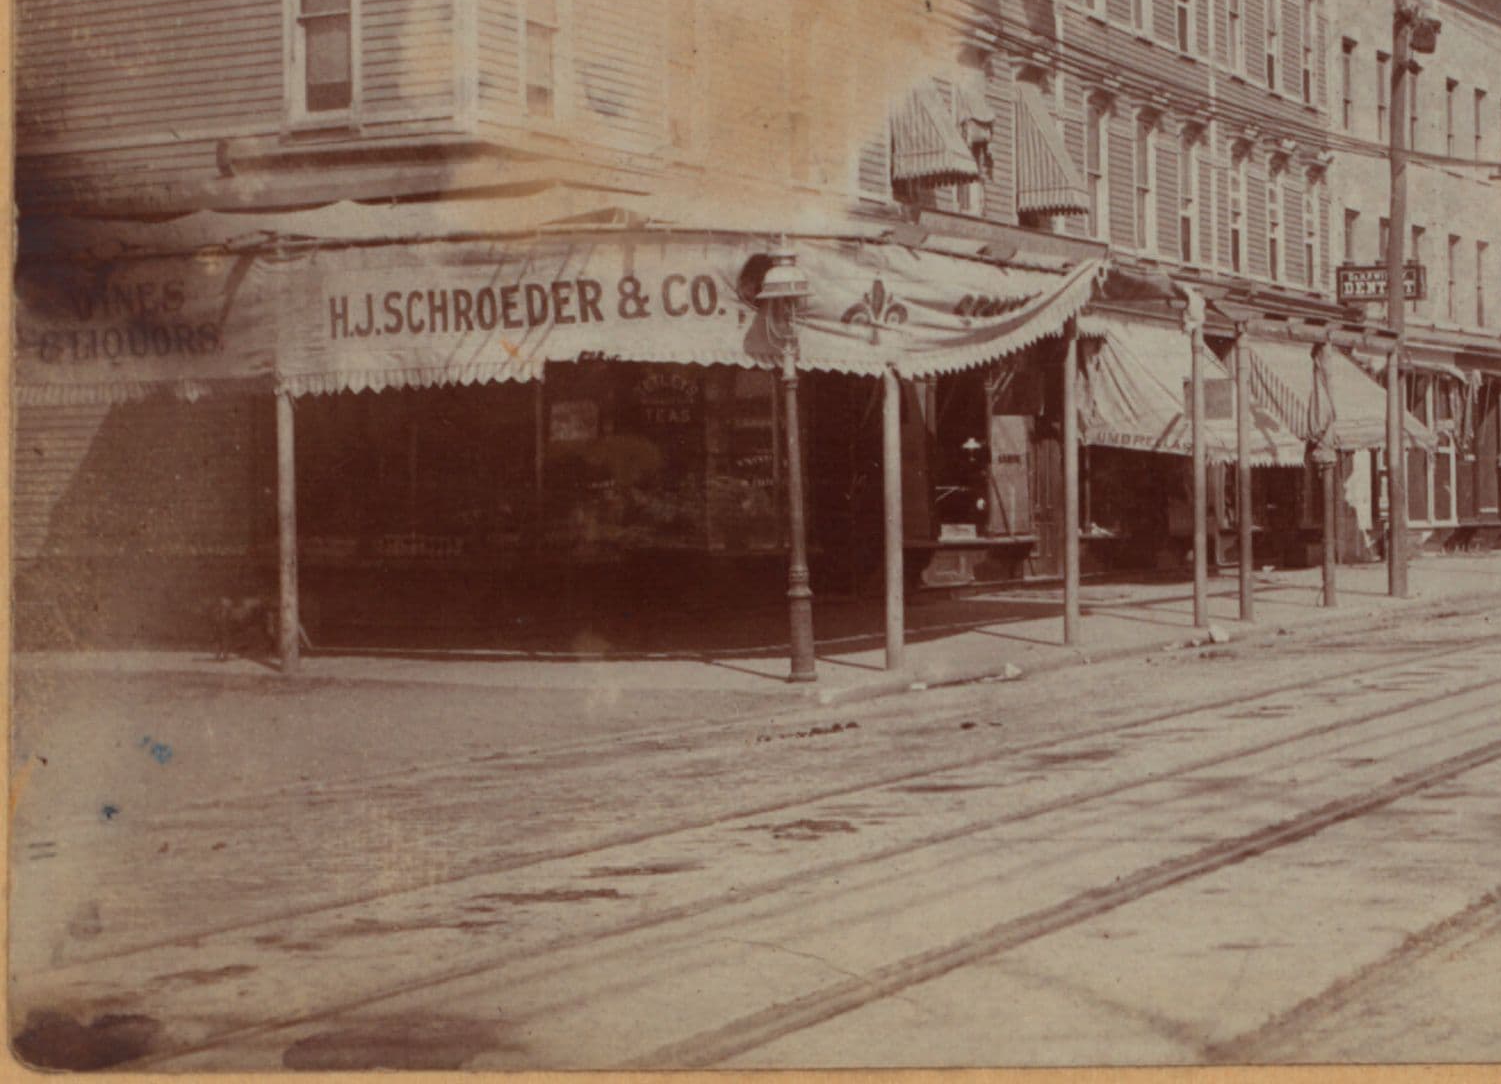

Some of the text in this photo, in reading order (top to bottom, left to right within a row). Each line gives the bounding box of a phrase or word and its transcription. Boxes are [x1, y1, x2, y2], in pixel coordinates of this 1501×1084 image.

[617, 276, 652, 320] &
[661, 273, 727, 318] CO.
[1343, 281, 1416, 294] DENTT
[1097, 430, 1194, 454] UMBRELAS
